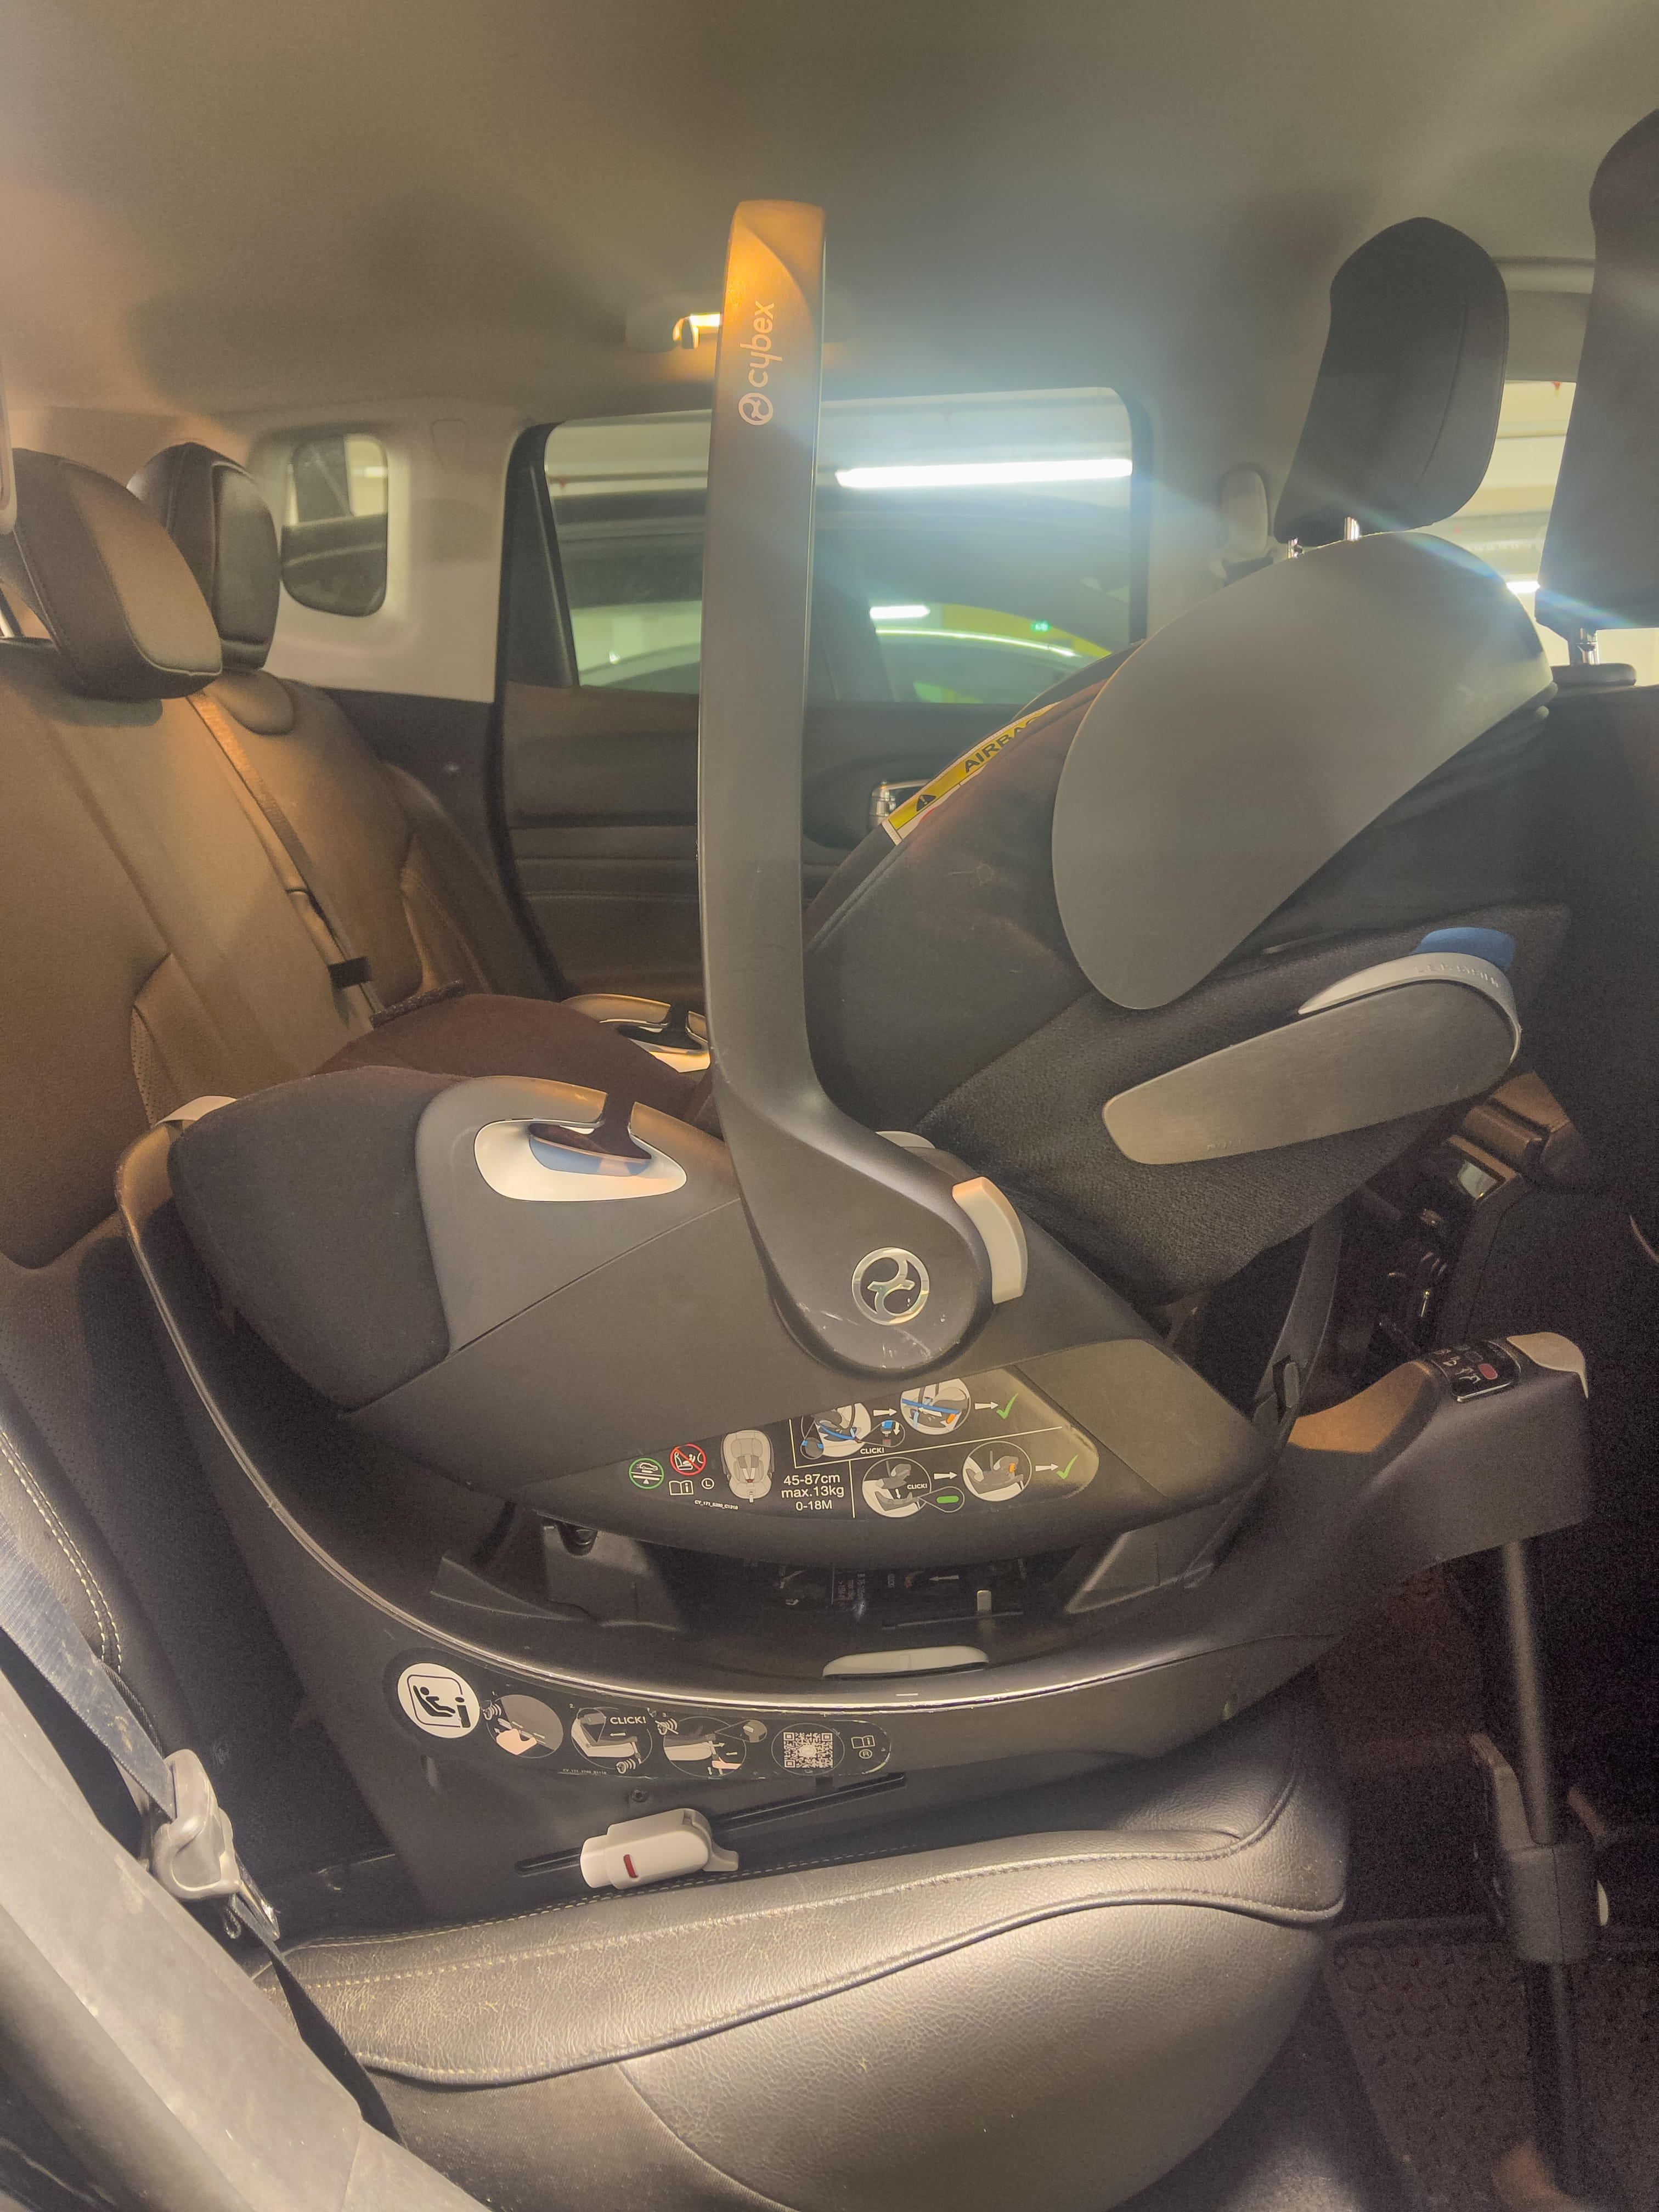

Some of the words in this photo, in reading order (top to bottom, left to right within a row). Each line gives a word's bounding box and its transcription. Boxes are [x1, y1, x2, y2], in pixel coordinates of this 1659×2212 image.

[740, 300, 783, 388] cybex
[965, 718, 1036, 774] AIRBA
[783, 1474, 840, 1486] 45-87cm
[781, 1485, 845, 1498] max.13kg
[795, 1499, 833, 1511] 0-18M
[610, 1716, 646, 1724] CLICK!
